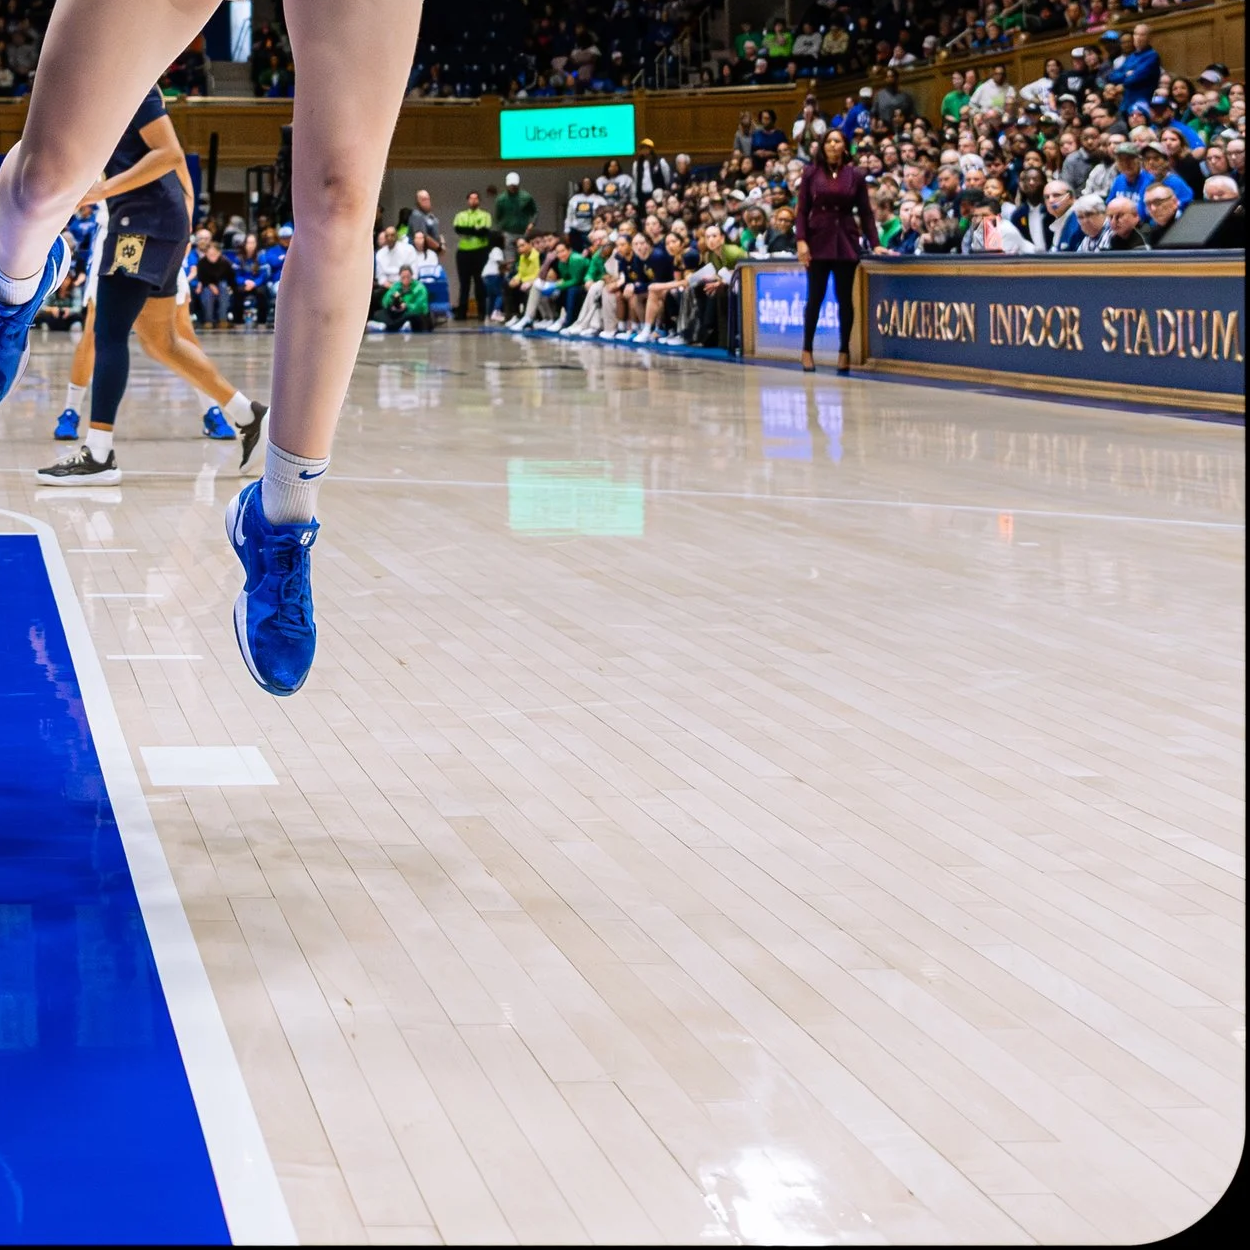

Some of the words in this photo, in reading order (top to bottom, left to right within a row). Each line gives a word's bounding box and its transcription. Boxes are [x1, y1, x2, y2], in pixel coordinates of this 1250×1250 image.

[525, 125, 564, 141] Uber
[567, 123, 608, 139] Eats
[875, 299, 976, 343] CAMERON
[988, 303, 1084, 350] INDOOR
[1101, 306, 1244, 363] STADIUM
